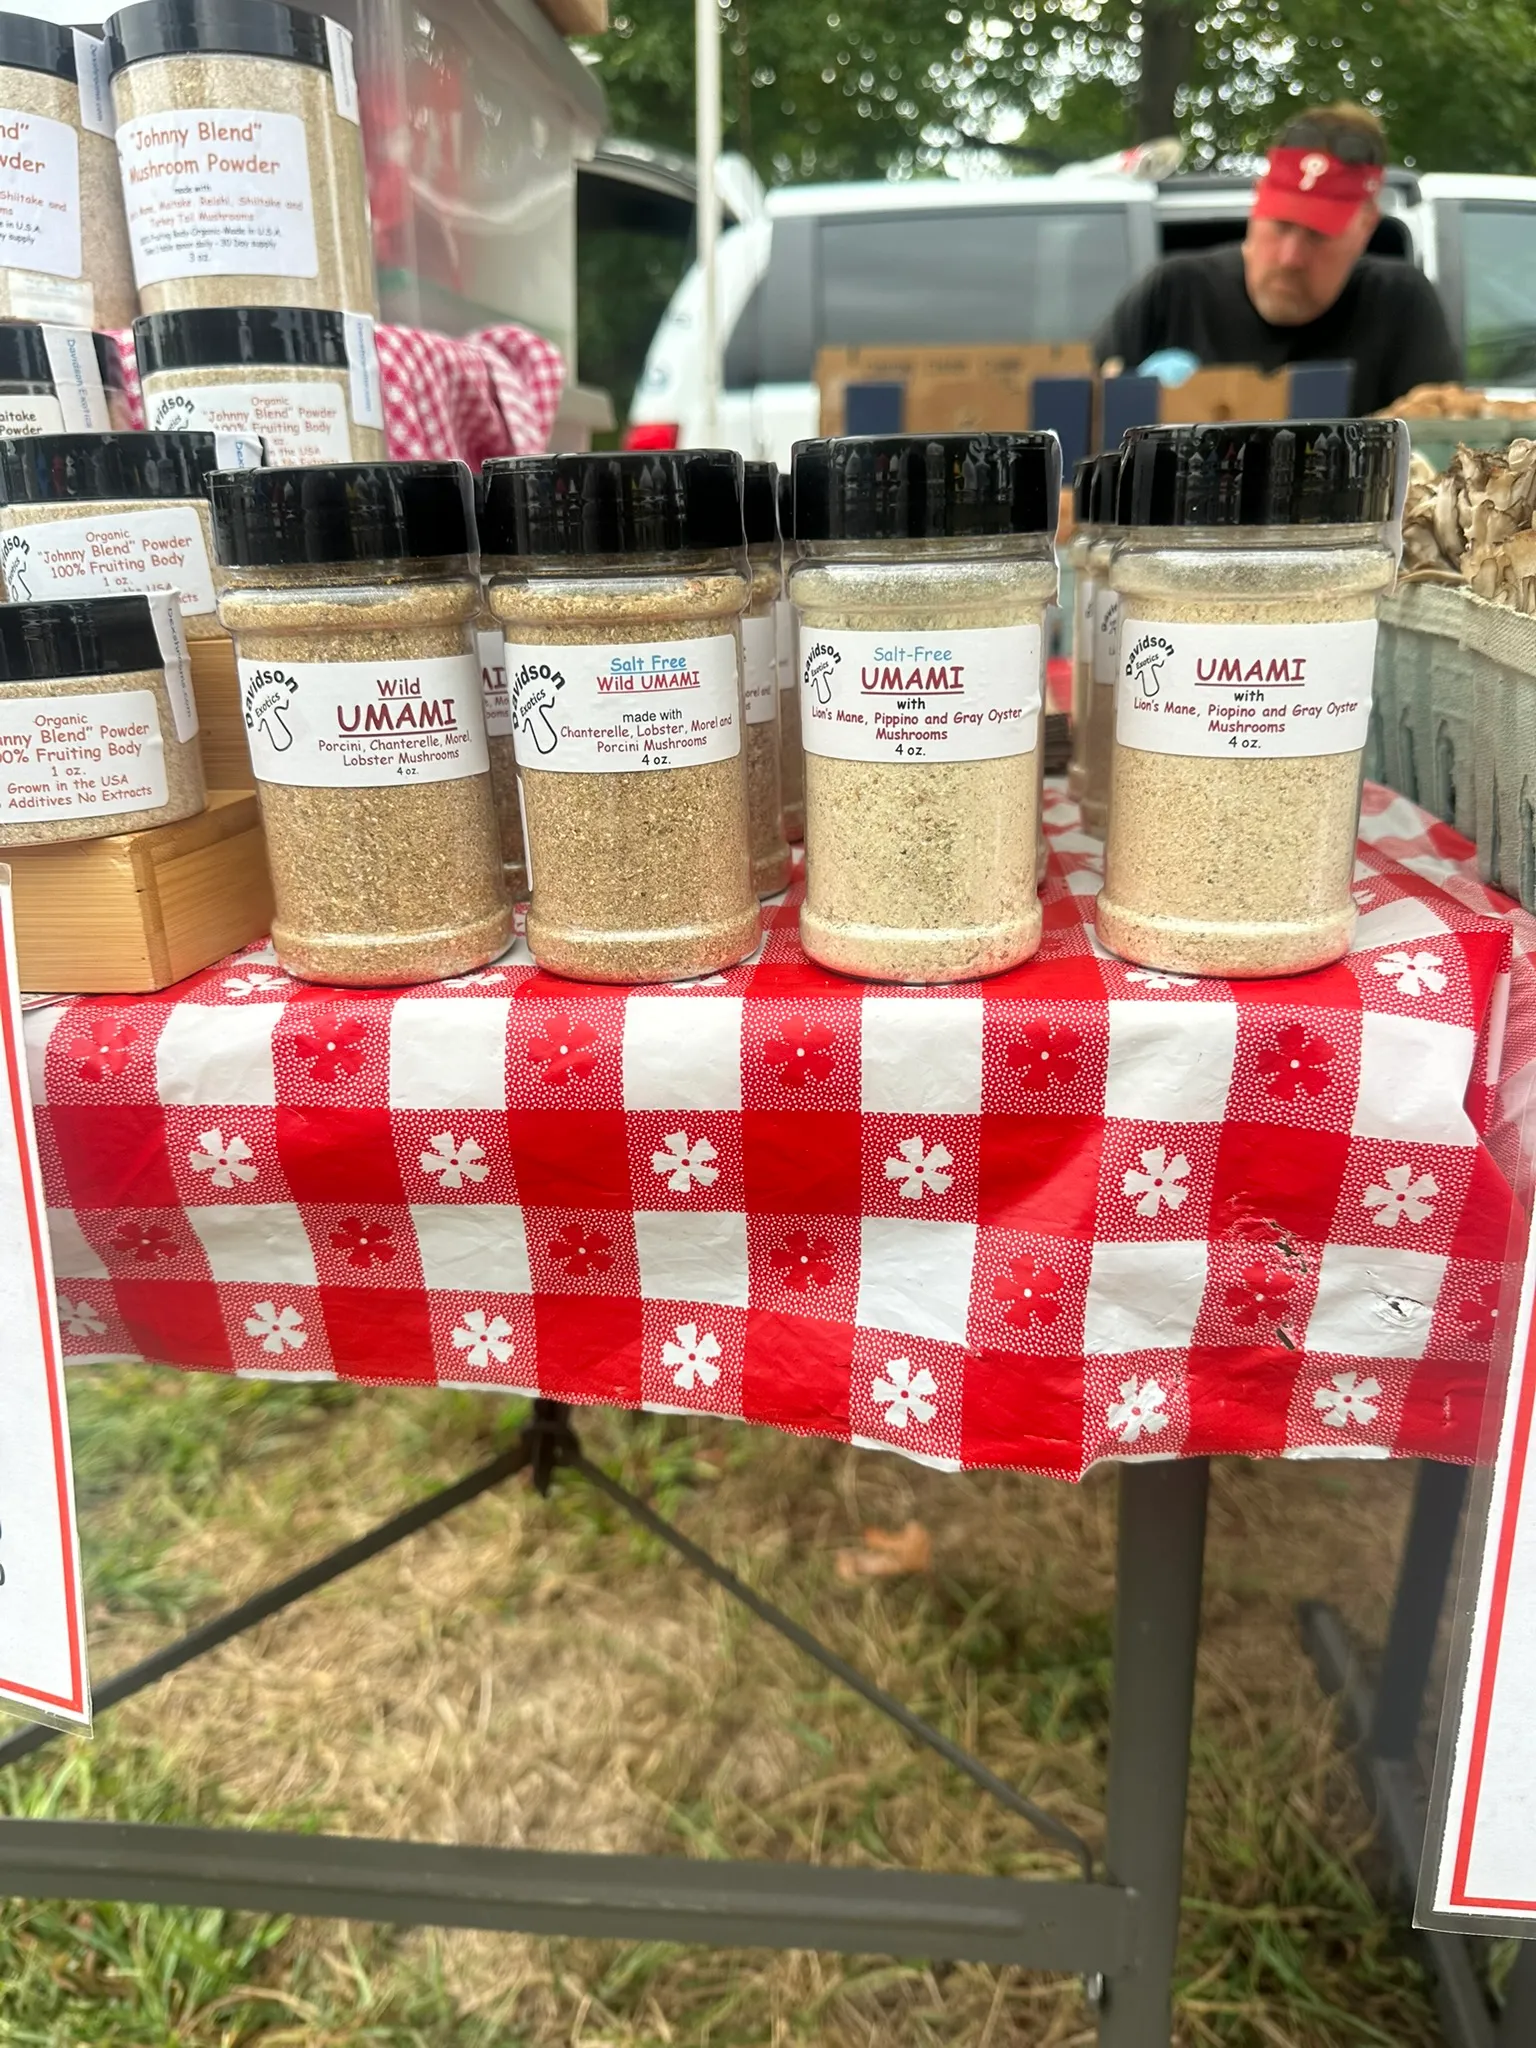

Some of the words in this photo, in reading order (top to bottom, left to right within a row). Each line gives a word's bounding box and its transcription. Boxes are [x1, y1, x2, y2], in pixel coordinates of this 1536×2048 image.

[129, 127, 189, 151] "Johnny
[197, 121, 262, 143] Blend"
[128, 159, 200, 185] Mushroom
[207, 153, 281, 175] Powder
[252, 396, 289, 408] Organic
[254, 406, 293, 420] Blend"
[298, 407, 337, 420] Powder
[252, 420, 301, 436] Fruiting
[305, 420, 332, 435] Body
[86, 529, 130, 543] Organic
[37, 548, 86, 565] "Johnny
[91, 540, 136, 558] Blend"
[142, 535, 192, 551] Powder
[51, 563, 86, 579] 100%
[89, 558, 146, 575] Fruiting
[151, 553, 185, 568] Body
[103, 577, 110, 587] 1
[610, 655, 644, 672] Salt
[652, 654, 687, 670] Free
[873, 645, 953, 662] Salt-Free
[1126, 635, 1175, 676] Davidson
[1135, 653, 1159, 670] Exotics
[804, 643, 842, 684] Davidson
[811, 660, 829, 677] Exotics
[1196, 657, 1307, 682] UMAMI
[376, 677, 422, 697] Wild
[597, 675, 634, 692] Wild
[641, 671, 701, 689] UMAMI
[861, 666, 965, 690] UMAMI
[245, 669, 300, 729] Davidson
[254, 692, 281, 718] Exotics
[512, 664, 566, 730] Davidson
[519, 689, 546, 717] Exotics
[896, 697, 926, 710] with
[1234, 689, 1265, 702] with
[337, 699, 457, 732] UMAMI
[622, 710, 657, 723] made
[659, 708, 683, 721] with
[812, 706, 833, 721] Lion's
[836, 709, 868, 726] Mane,
[874, 712, 919, 727] Pippino
[924, 712, 948, 725] and
[953, 711, 984, 726] Gray
[988, 707, 1023, 725] Oyster
[1133, 697, 1160, 713] Lion's
[1163, 703, 1201, 719] Mane,
[1208, 704, 1256, 720] Piopino
[1262, 704, 1287, 717] and
[1292, 704, 1322, 719] Gray
[1326, 701, 1359, 716] Oyster
[34, 713, 88, 729] Organic
[560, 725, 634, 739] Chanterelle,
[636, 724, 688, 738] Lobster,
[691, 716, 718, 732] Morel
[719, 713, 732, 727] and
[1208, 720, 1286, 733] Mushrooms
[41, 726, 94, 744] Blend"
[100, 722, 150, 739] Powder
[875, 727, 948, 740] Mushrooms
[1228, 735, 1238, 748] 4
[1241, 738, 1262, 749] oz.
[37, 747, 101, 763] Fruiting
[108, 741, 142, 757] Body
[318, 739, 366, 753] Porcini,
[369, 736, 442, 751] Chanterelle,
[597, 739, 639, 753] Porcini
[643, 735, 707, 751] Mushrooms
[894, 743, 904, 756] 4
[907, 746, 926, 756] oz.
[343, 753, 394, 767] Lobster
[398, 748, 460, 765] Mushrooms
[641, 754, 650, 766] 4
[653, 755, 671, 765] oz.
[51, 766, 59, 777] 1
[65, 766, 87, 776] oz.
[396, 767, 403, 776] 4
[405, 767, 419, 775] oz.
[7, 781, 51, 794] Grown
[56, 780, 68, 791] in
[73, 778, 96, 789] the
[101, 775, 129, 787] USA
[8, 794, 73, 809] Additives
[78, 793, 97, 804] No
[102, 786, 153, 802] Extracts
